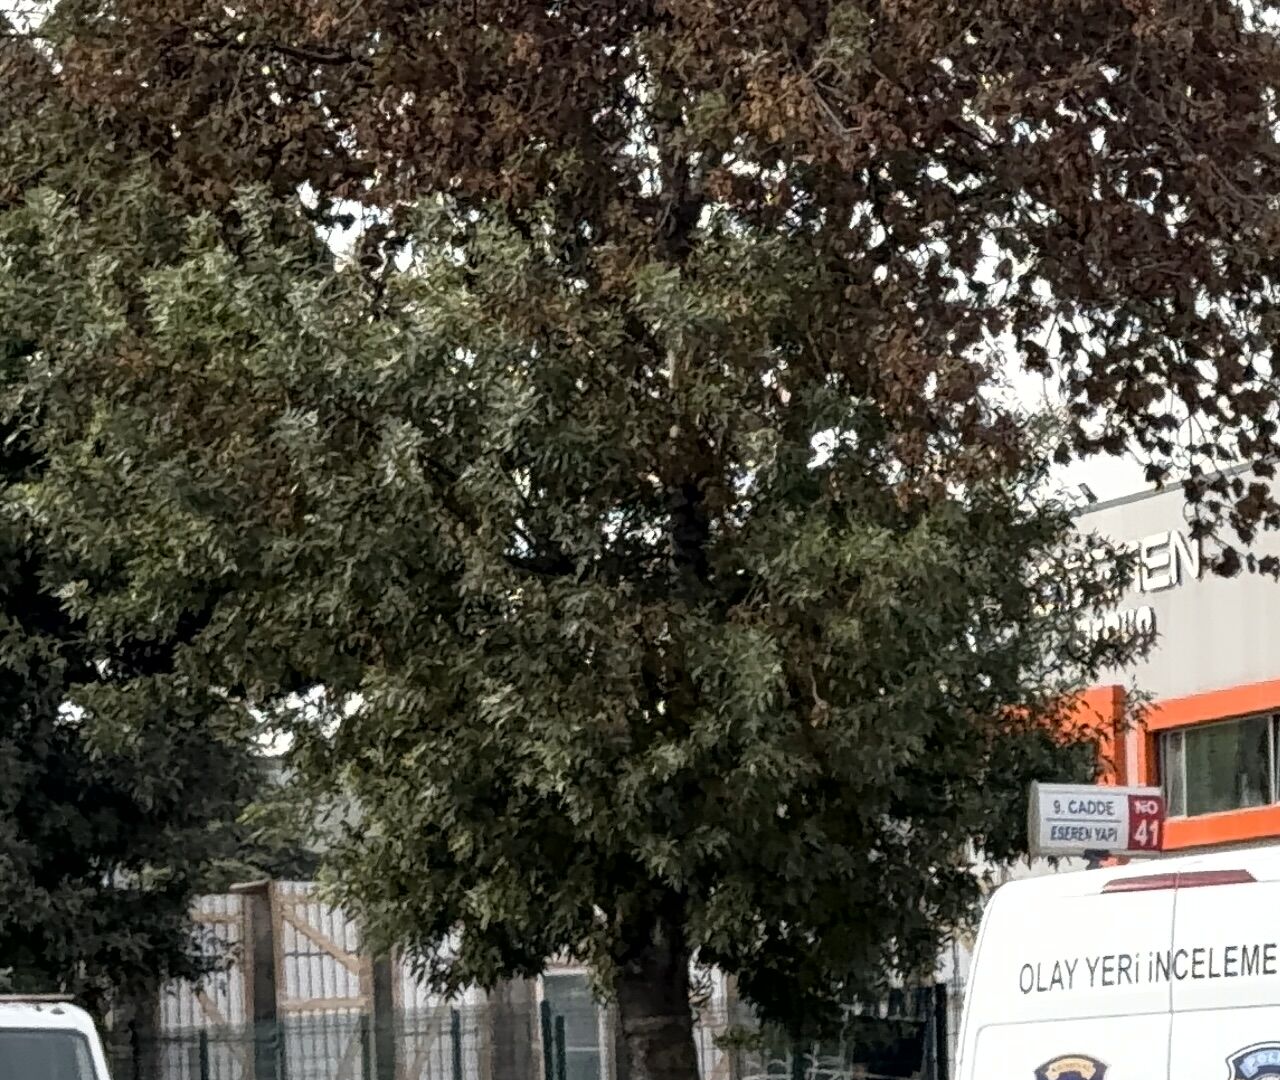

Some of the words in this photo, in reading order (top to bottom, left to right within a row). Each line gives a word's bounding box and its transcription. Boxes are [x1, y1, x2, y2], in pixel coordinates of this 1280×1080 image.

[1068, 800, 1116, 816] CADDE
[1134, 819, 1160, 846] 41
[1019, 957, 1079, 995] OLAY
